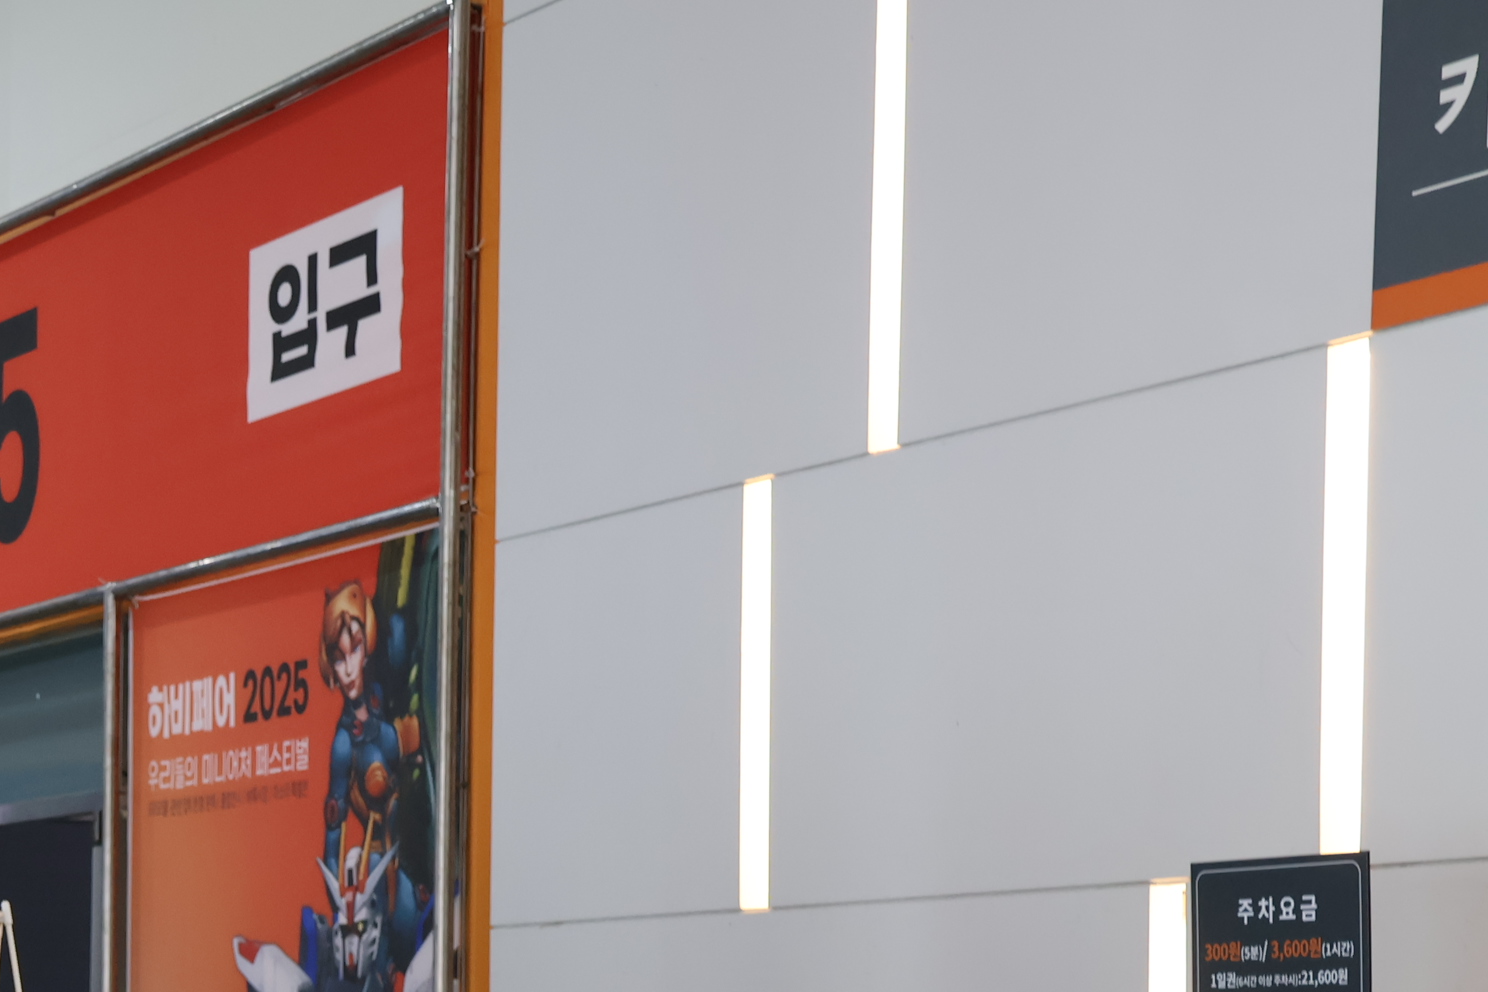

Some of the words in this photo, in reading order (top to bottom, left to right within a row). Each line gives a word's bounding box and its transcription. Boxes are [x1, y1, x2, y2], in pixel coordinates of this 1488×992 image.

[268, 228, 382, 383] 입구
[147, 671, 237, 739] 하비페어
[242, 659, 310, 724] 2025
[148, 754, 199, 791] 우리들의
[255, 737, 310, 777] 페스티벌
[1238, 894, 1318, 925] 주차요금
